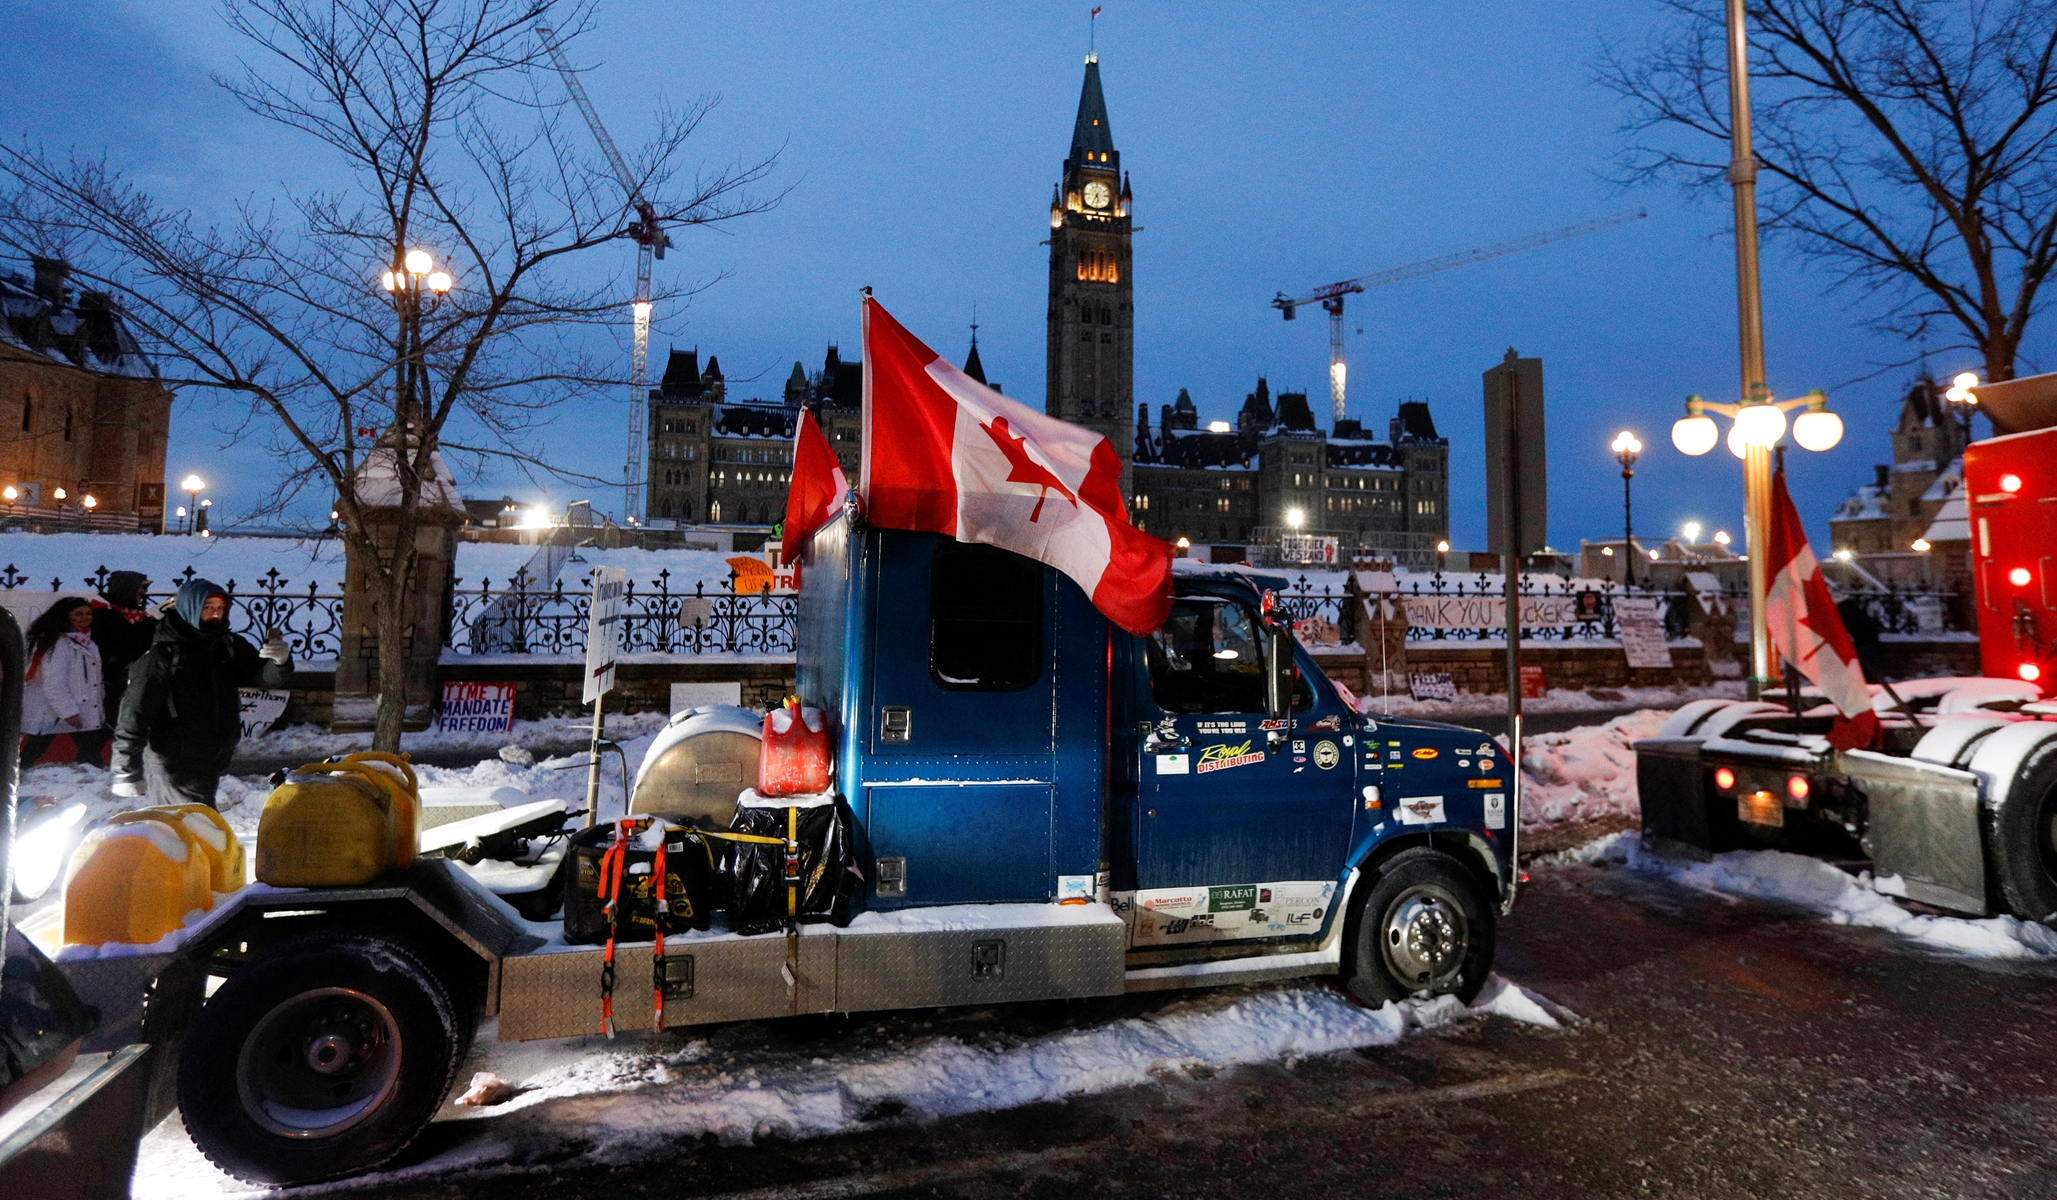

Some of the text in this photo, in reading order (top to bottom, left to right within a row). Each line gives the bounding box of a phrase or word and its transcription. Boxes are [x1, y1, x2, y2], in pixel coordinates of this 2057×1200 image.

[1458, 600, 1492, 624] YOU
[444, 684, 514, 700] TIME TO
[442, 699, 510, 716] MANDATE
[440, 717, 508, 732] FREEDOM
[1198, 740, 1251, 765] Royal
[1199, 752, 1264, 772] DISTRIBUTING
[1224, 888, 1254, 899] RAFAT
[1110, 897, 1134, 912] Bell
